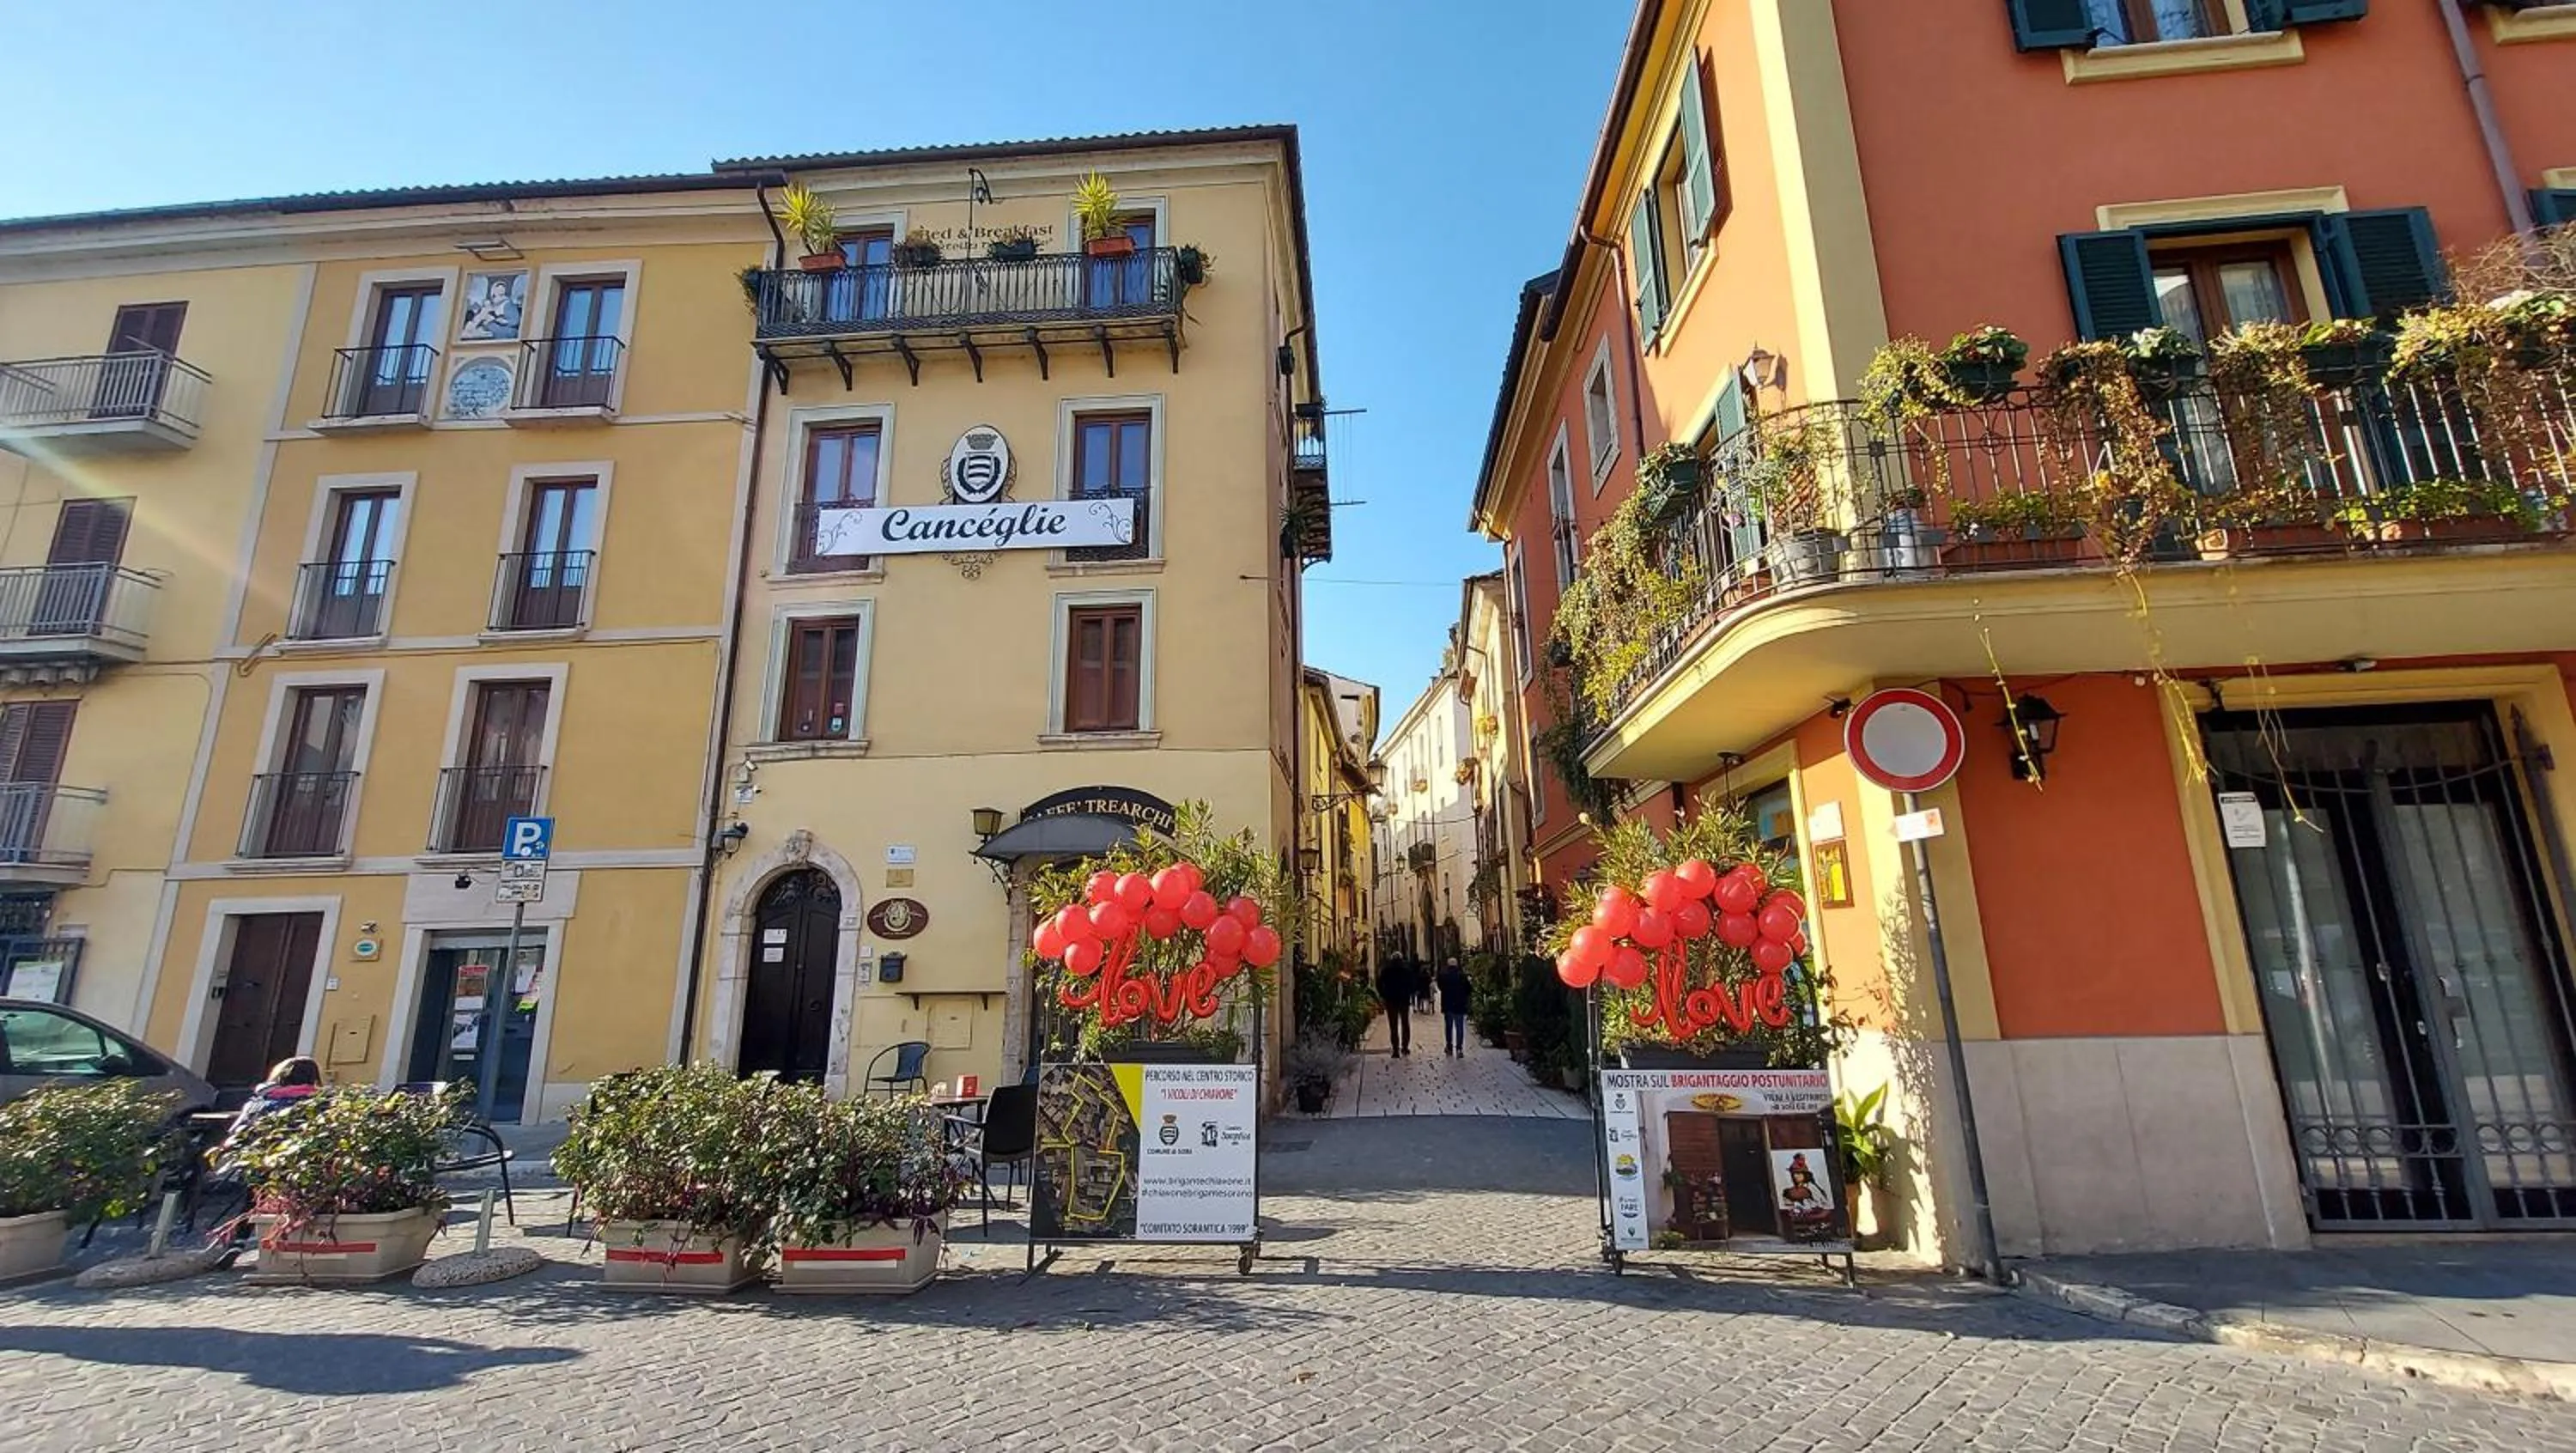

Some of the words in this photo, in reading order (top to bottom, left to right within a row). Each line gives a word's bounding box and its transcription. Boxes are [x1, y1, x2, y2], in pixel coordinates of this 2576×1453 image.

[882, 505, 1066, 546] Cancéglie
[1085, 799, 1174, 829] TREARCHI
[513, 822, 542, 854] P
[1197, 1070, 1223, 1081] CENTRO
[1607, 1074, 1648, 1088] MOSTRA
[1649, 1074, 1669, 1088] SUL
[1670, 1074, 1749, 1088] BRIGANTAGGIO
[1752, 1074, 1827, 1088] POSTUNITARIO
